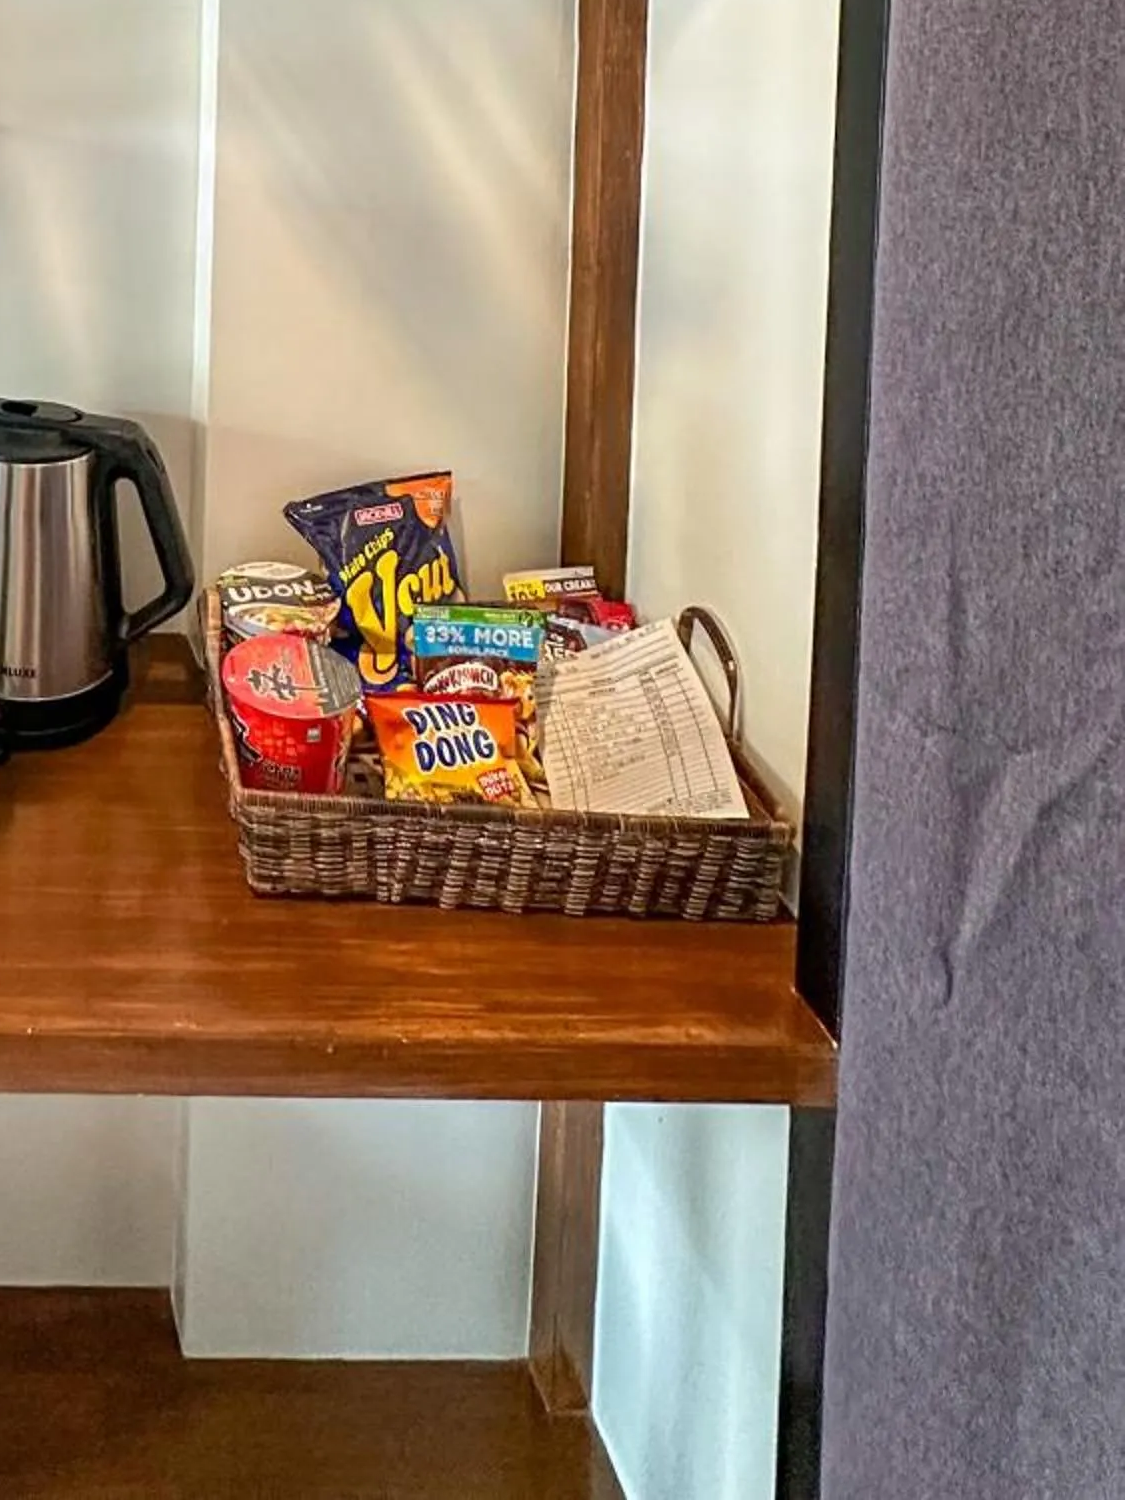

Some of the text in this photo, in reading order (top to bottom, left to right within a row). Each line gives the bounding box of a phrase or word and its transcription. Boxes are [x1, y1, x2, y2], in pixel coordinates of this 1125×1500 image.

[228, 580, 315, 602] UDON
[425, 625, 466, 644] 33%
[473, 627, 535, 649] MORE
[404, 702, 476, 736] DING
[413, 729, 495, 773] DONG
